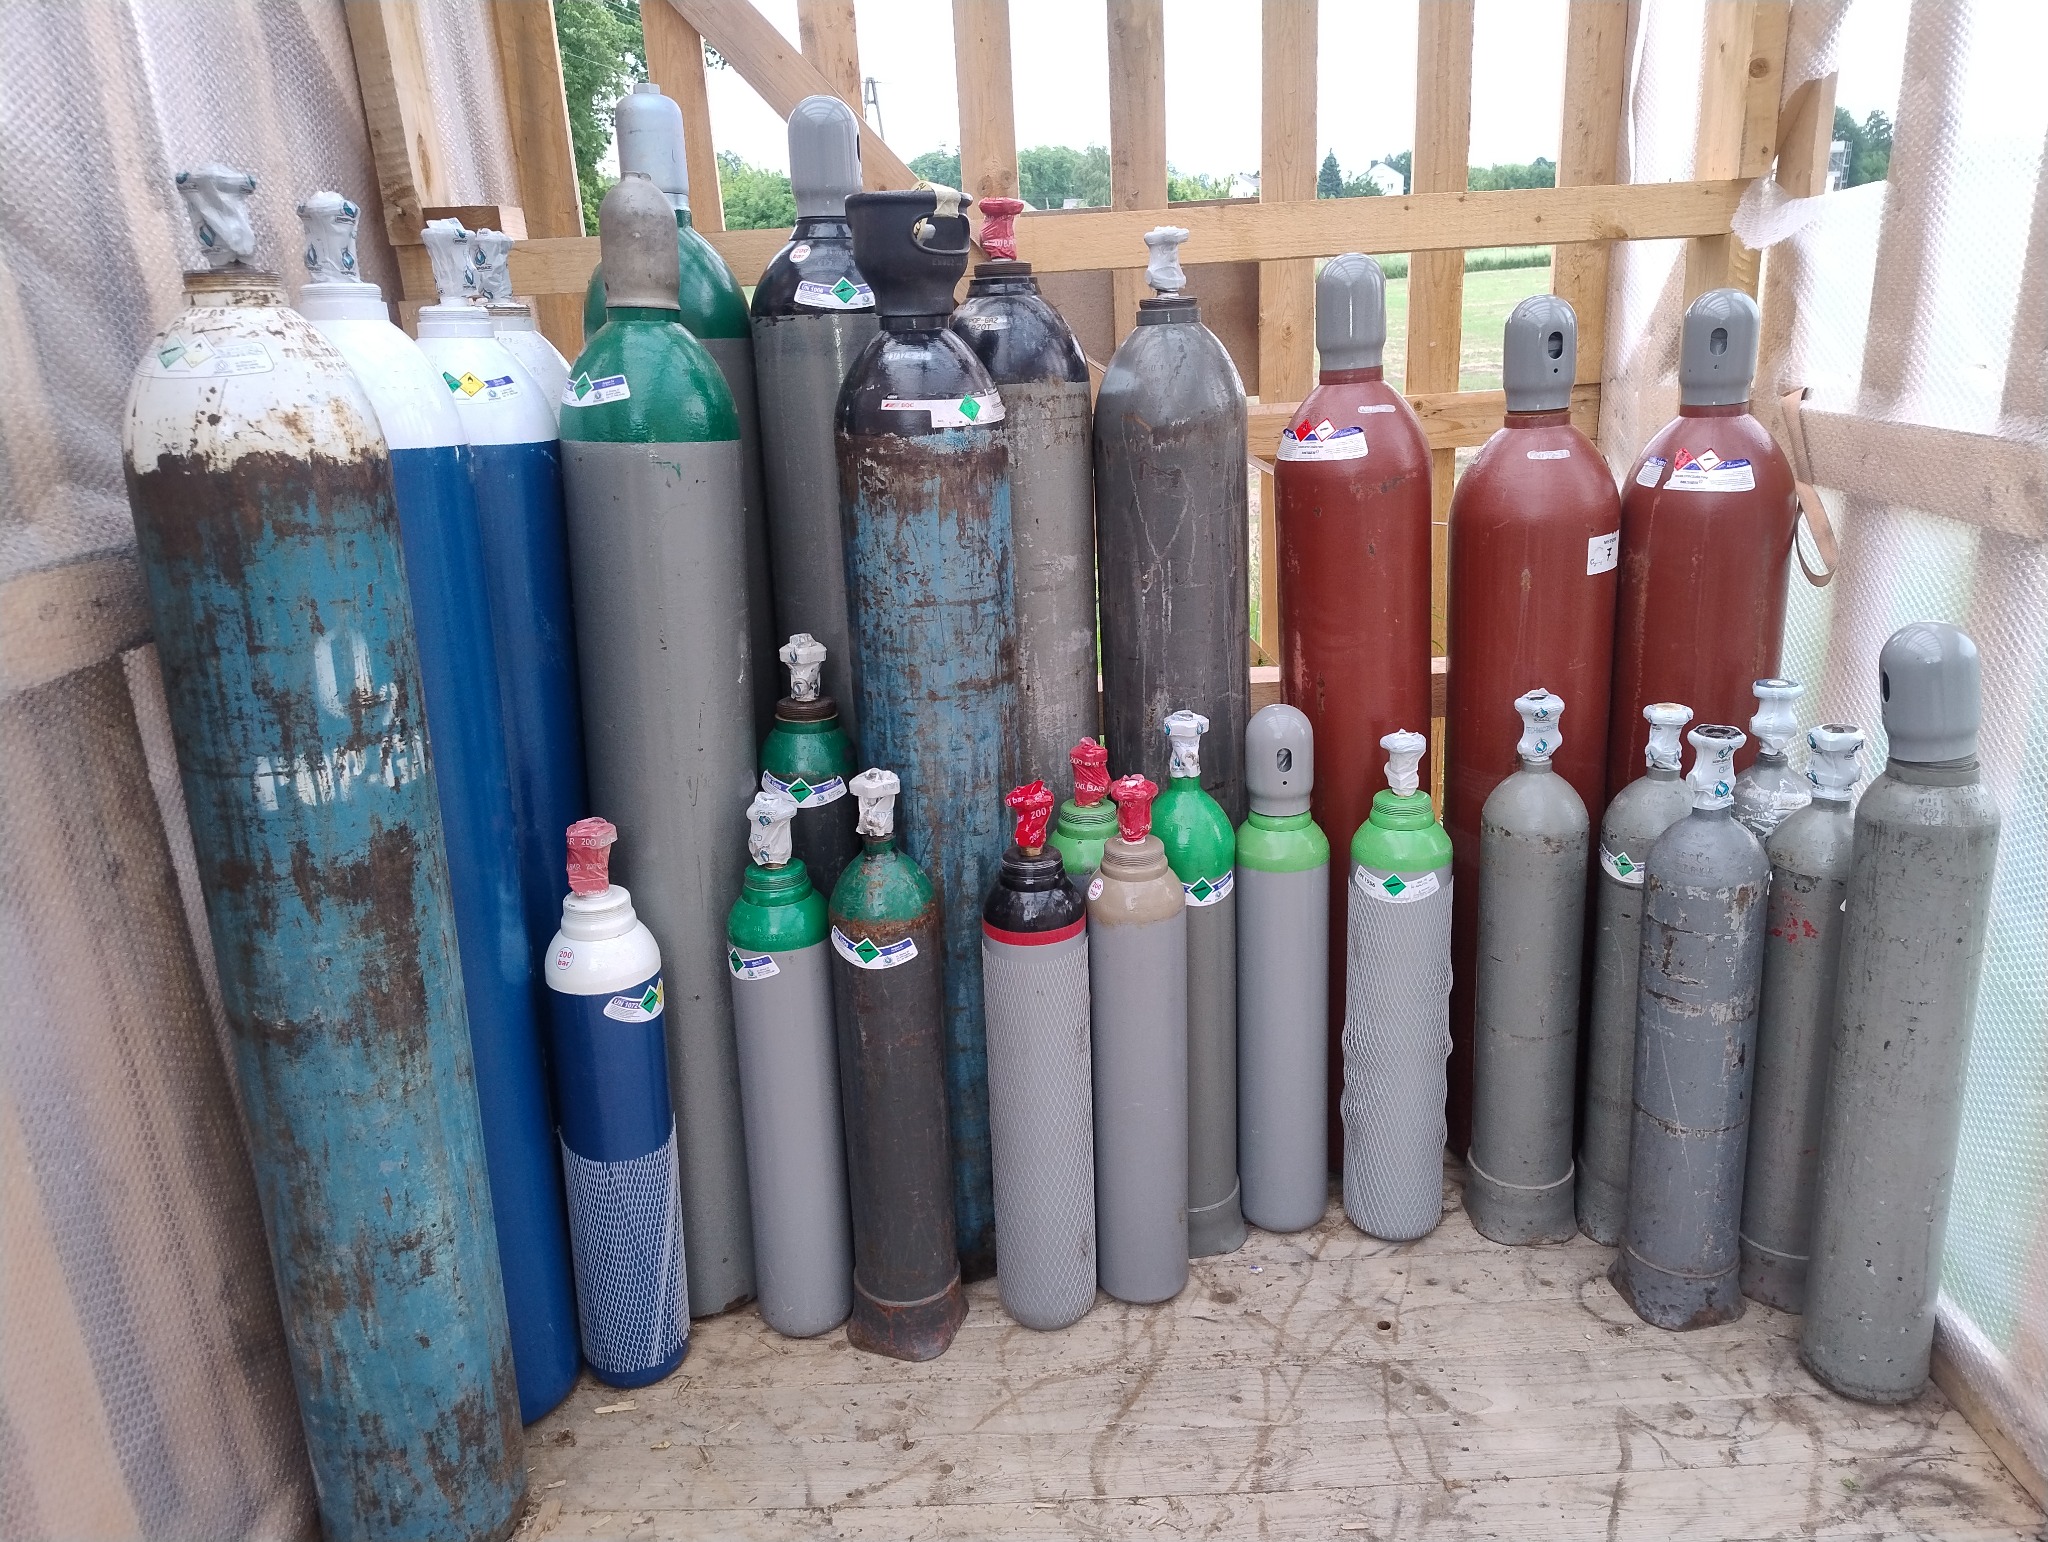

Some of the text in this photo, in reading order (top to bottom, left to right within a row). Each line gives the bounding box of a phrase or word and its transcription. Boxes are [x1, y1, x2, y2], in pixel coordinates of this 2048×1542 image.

[1030, 807, 1047, 820] 200
[581, 838, 597, 847] 200
[559, 950, 573, 959] 200
[557, 958, 570, 967] bar
[613, 998, 639, 1010] UN 1072
